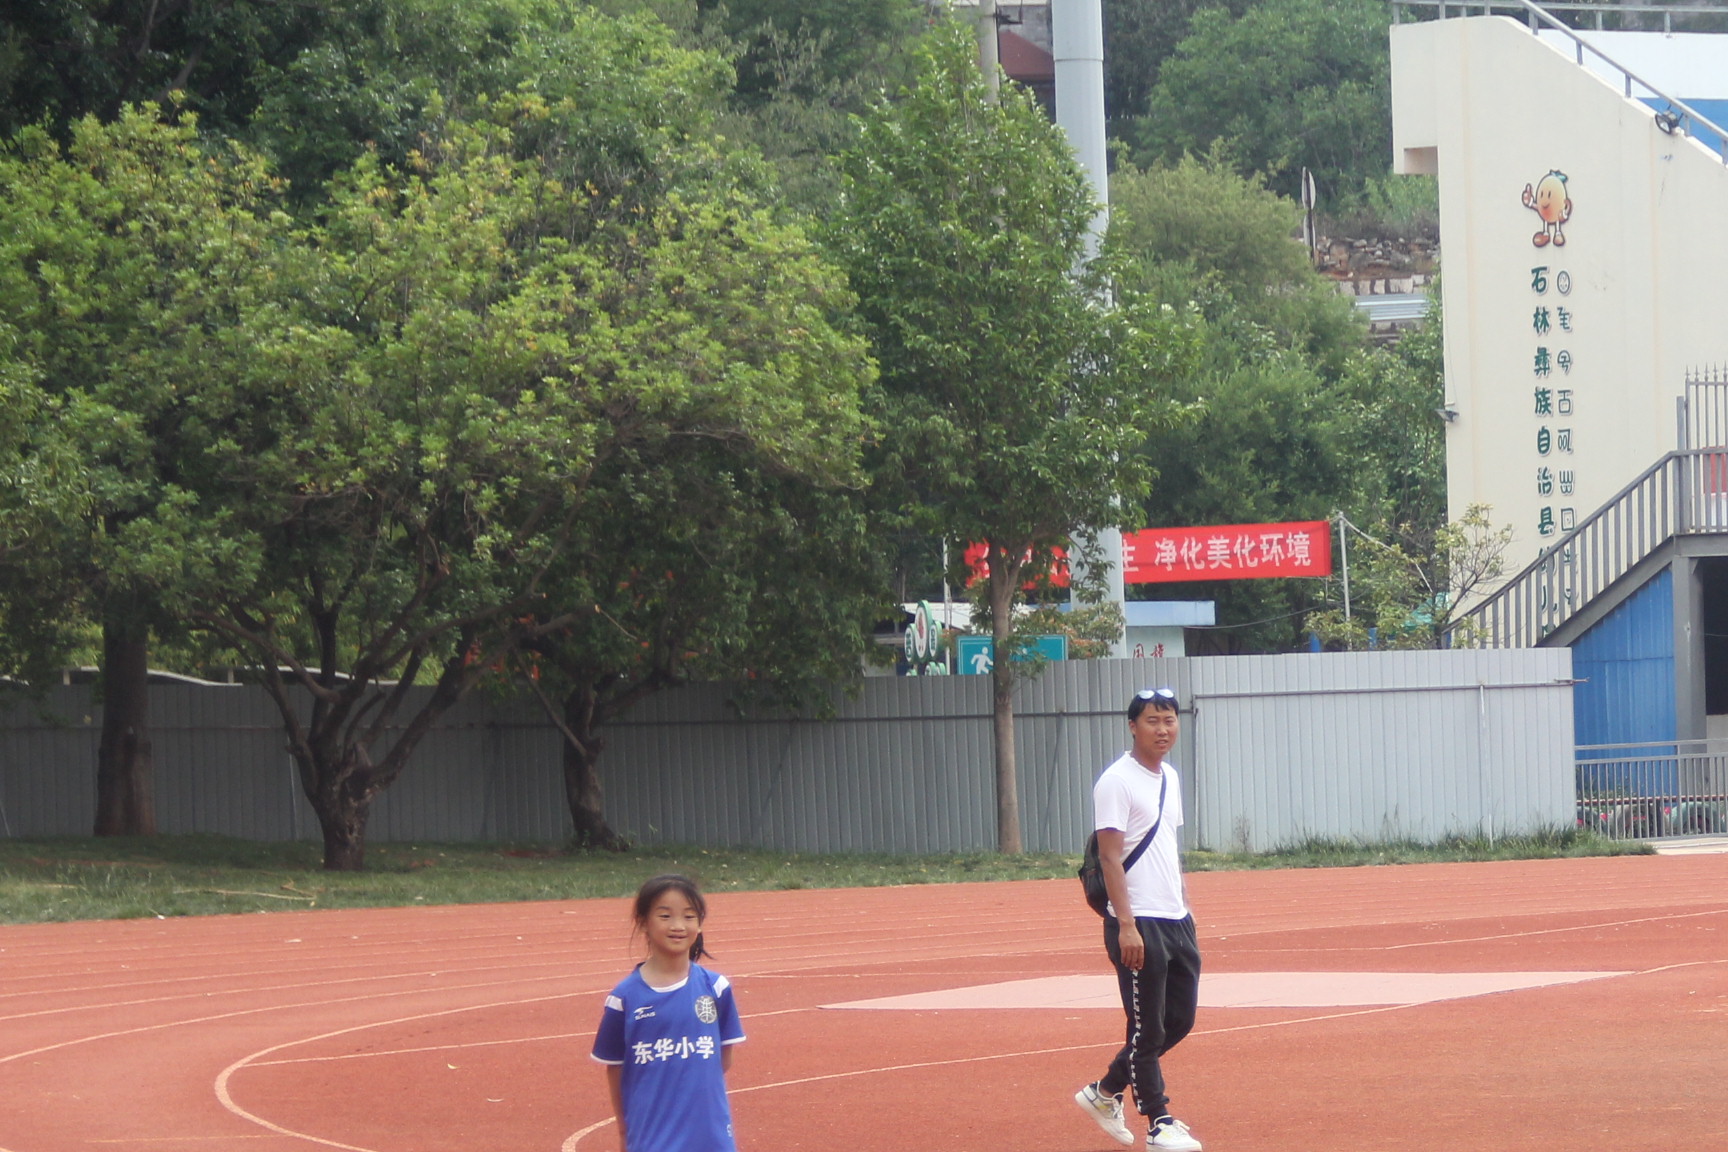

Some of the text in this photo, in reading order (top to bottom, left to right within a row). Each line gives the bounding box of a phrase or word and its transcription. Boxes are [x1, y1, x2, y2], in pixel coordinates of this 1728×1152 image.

[1531, 266, 1556, 638] 石林彝族自治县
[1154, 531, 1311, 572] 净化美化环境
[631, 1035, 715, 1065] 东华小学
